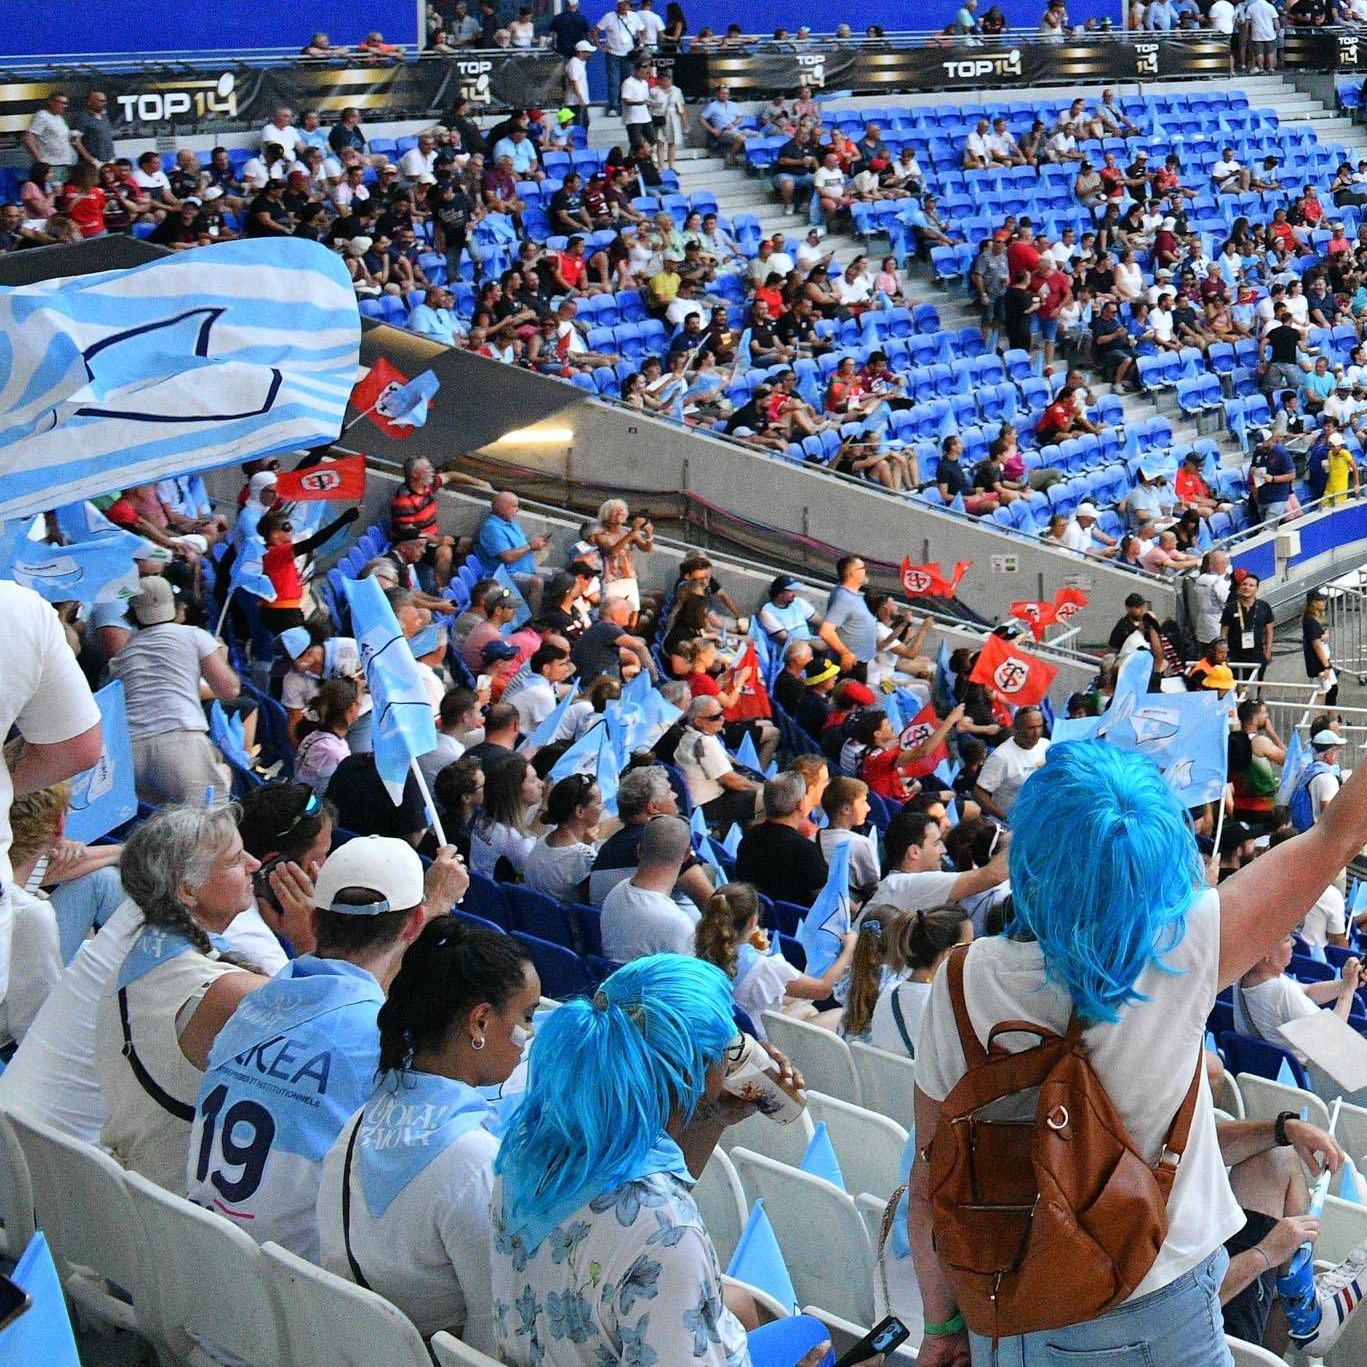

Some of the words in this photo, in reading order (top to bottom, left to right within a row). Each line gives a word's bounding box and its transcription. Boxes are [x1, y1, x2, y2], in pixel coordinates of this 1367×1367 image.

[1338, 36, 1358, 45] TOP
[1134, 43, 1159, 53] TOP
[796, 55, 825, 66] TOP
[457, 61, 493, 74] TOP
[197, 1083, 275, 1203] 19
